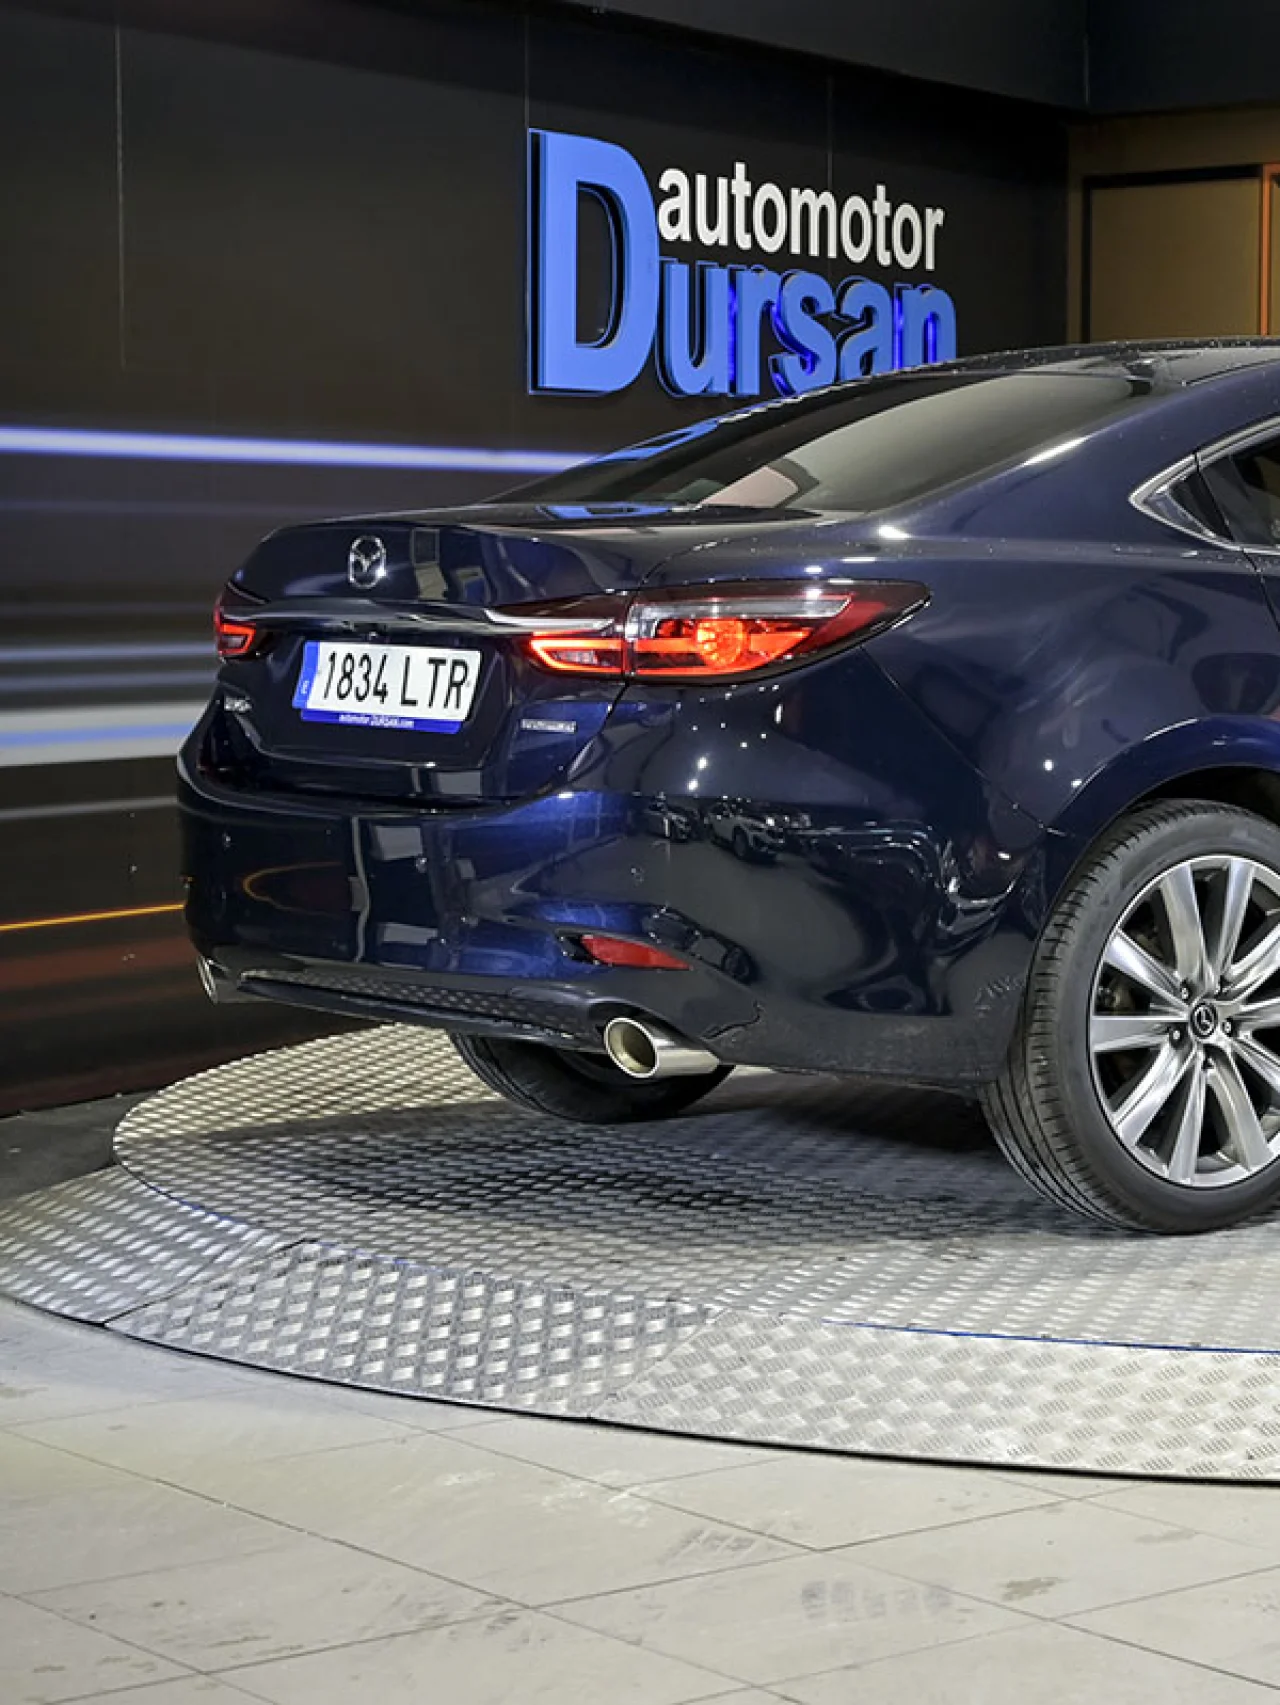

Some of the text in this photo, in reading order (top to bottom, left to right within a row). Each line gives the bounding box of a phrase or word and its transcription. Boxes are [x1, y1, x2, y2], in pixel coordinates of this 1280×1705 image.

[528, 128, 957, 397] Dursan
[658, 162, 944, 271] automotor
[324, 651, 469, 709] 1834 LTR
